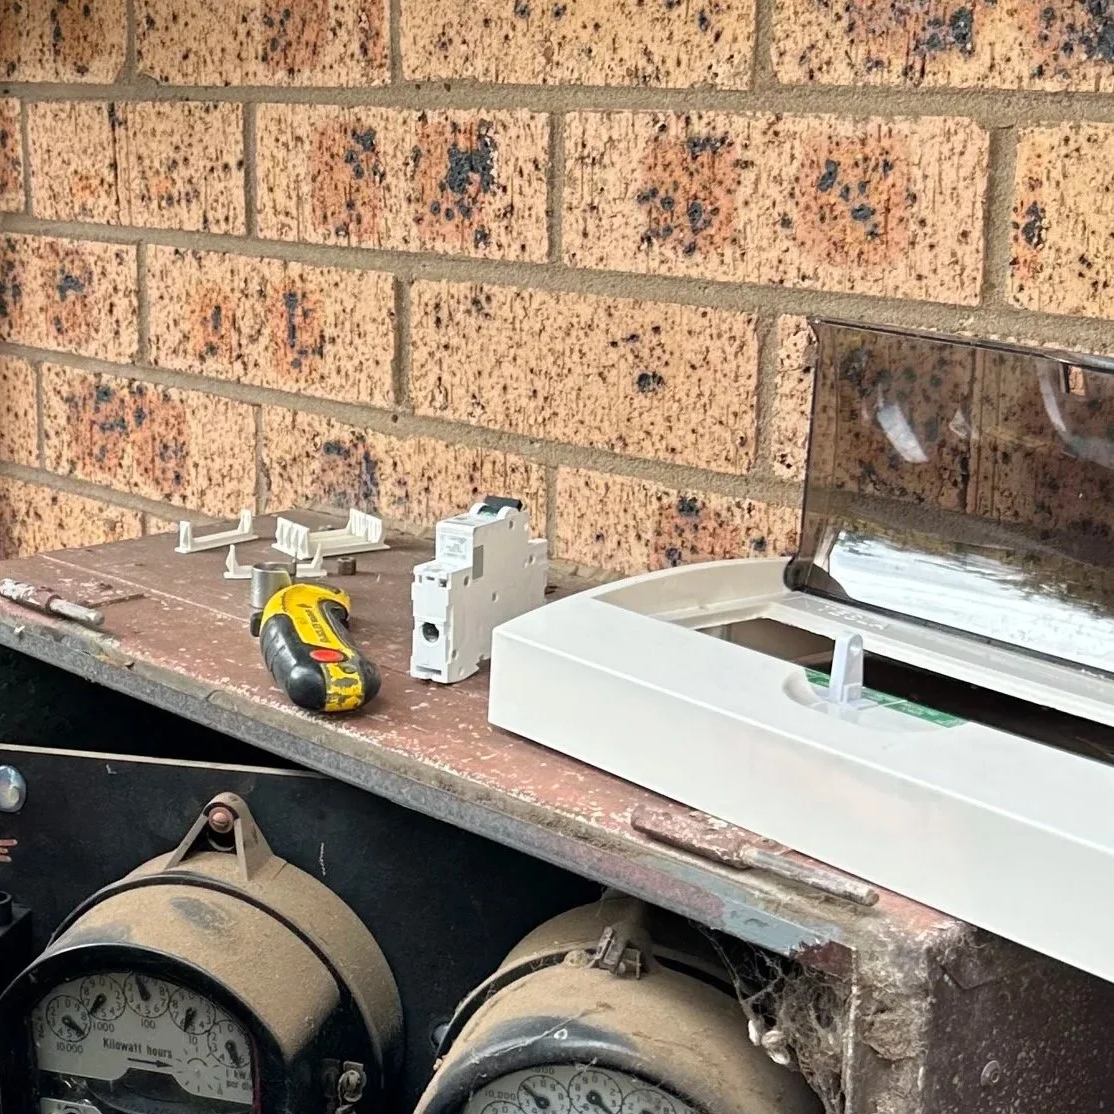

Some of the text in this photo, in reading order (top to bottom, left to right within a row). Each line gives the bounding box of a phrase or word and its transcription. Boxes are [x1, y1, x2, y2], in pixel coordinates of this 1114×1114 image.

[141, 1019, 156, 1029] 100
[188, 1035, 197, 1045] 10
[103, 1037, 173, 1059] Kilowatt hours
